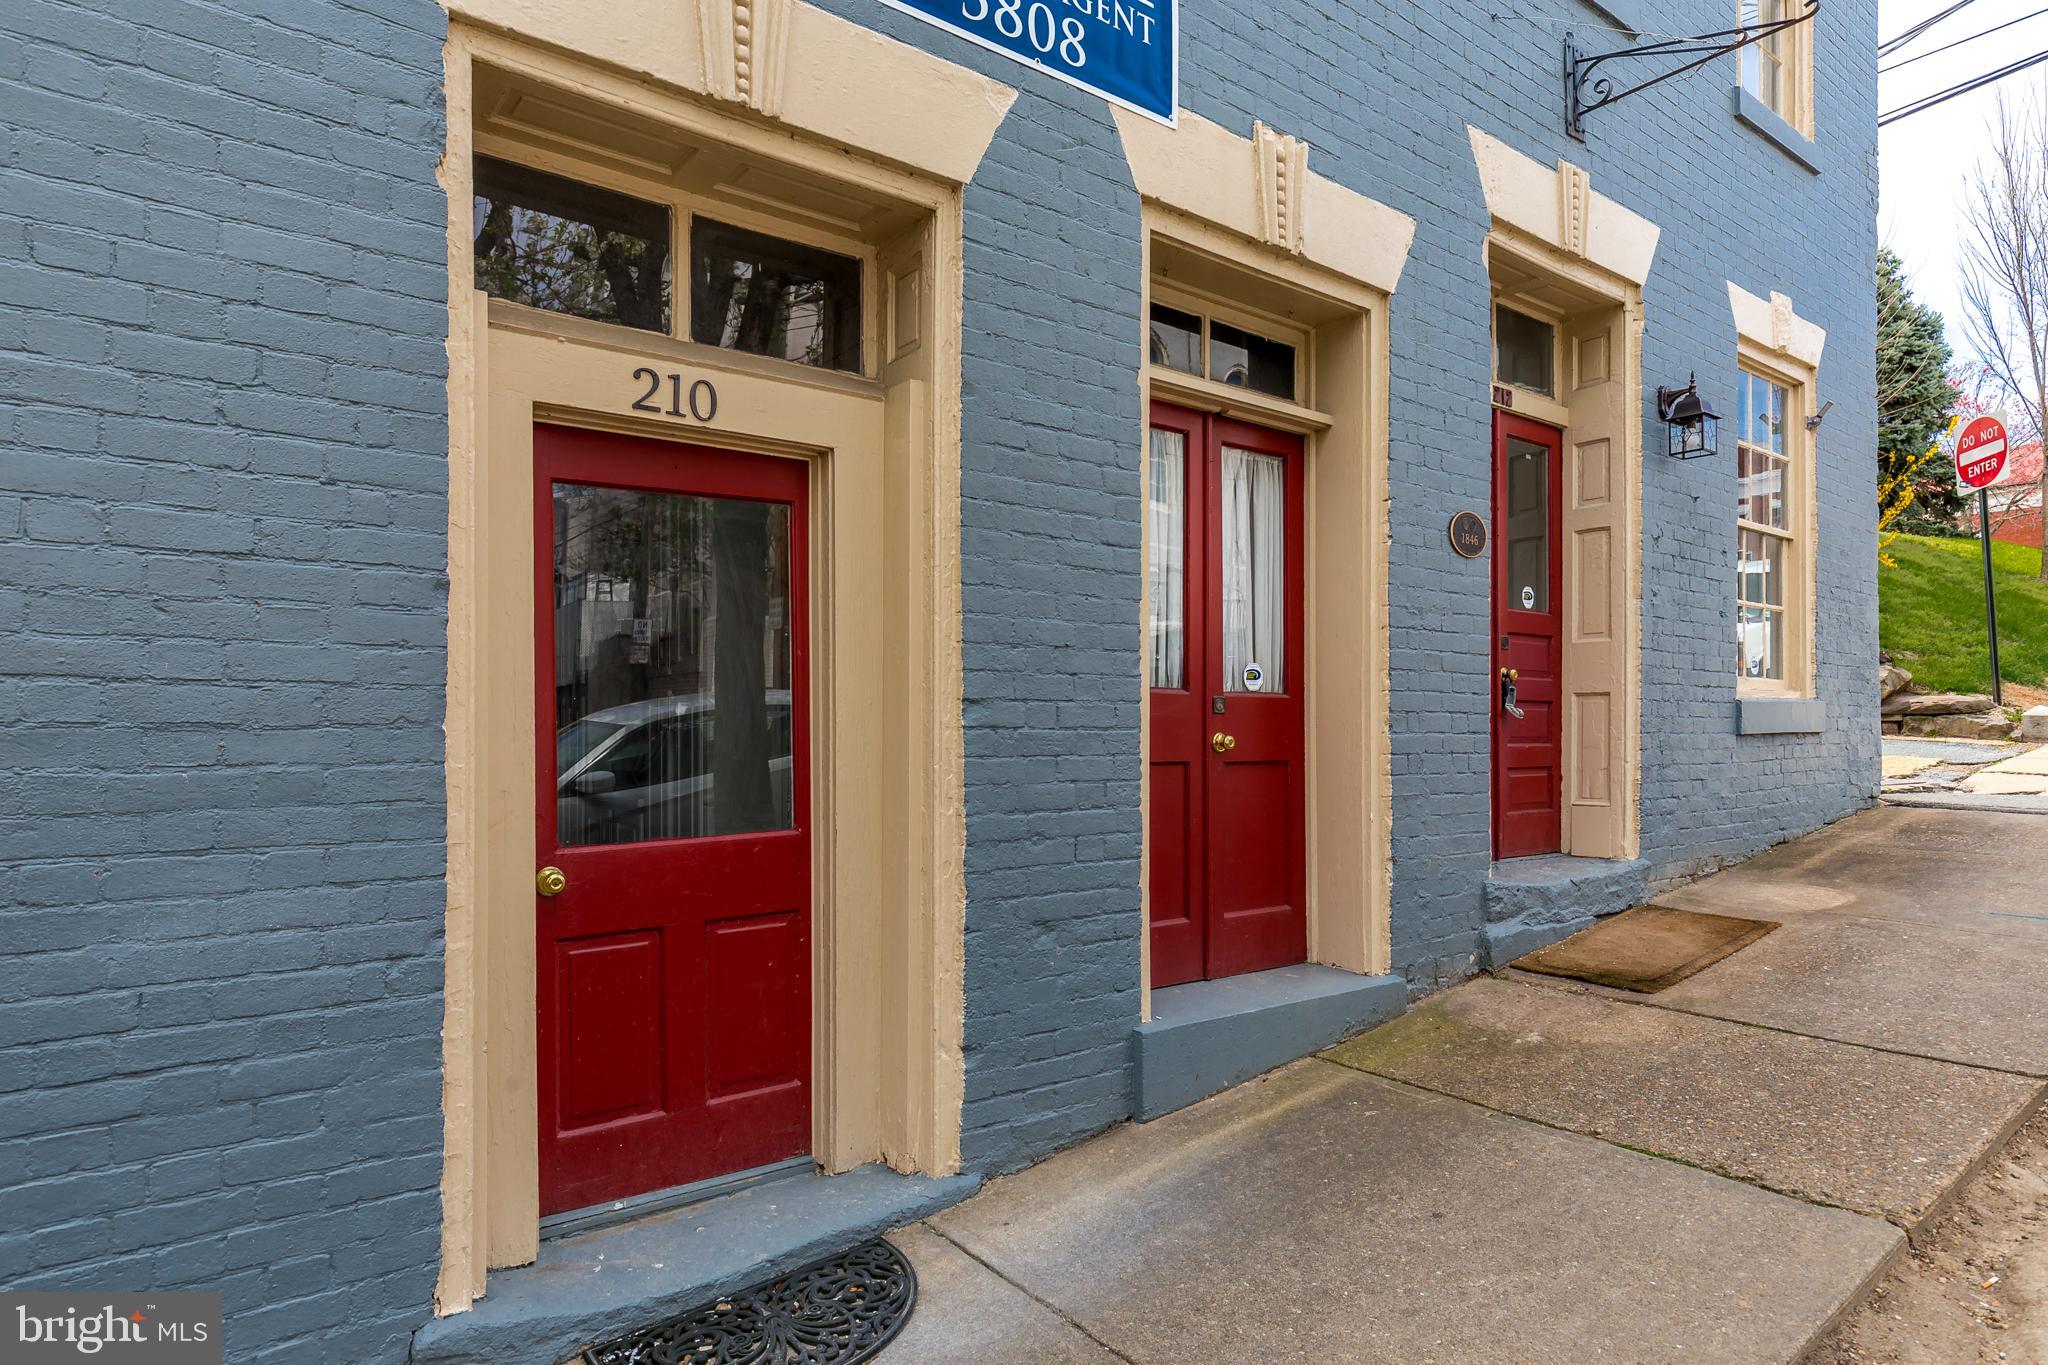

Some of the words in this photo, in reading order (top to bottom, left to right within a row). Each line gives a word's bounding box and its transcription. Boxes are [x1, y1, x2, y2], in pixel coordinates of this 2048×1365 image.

[1062, 0, 1155, 45] GENT
[632, 367, 717, 421] 210
[1962, 435, 1975, 448] DO
[1981, 426, 1999, 442] NOT
[1968, 458, 1998, 478] ENTER
[1461, 533, 1479, 545] 1846
